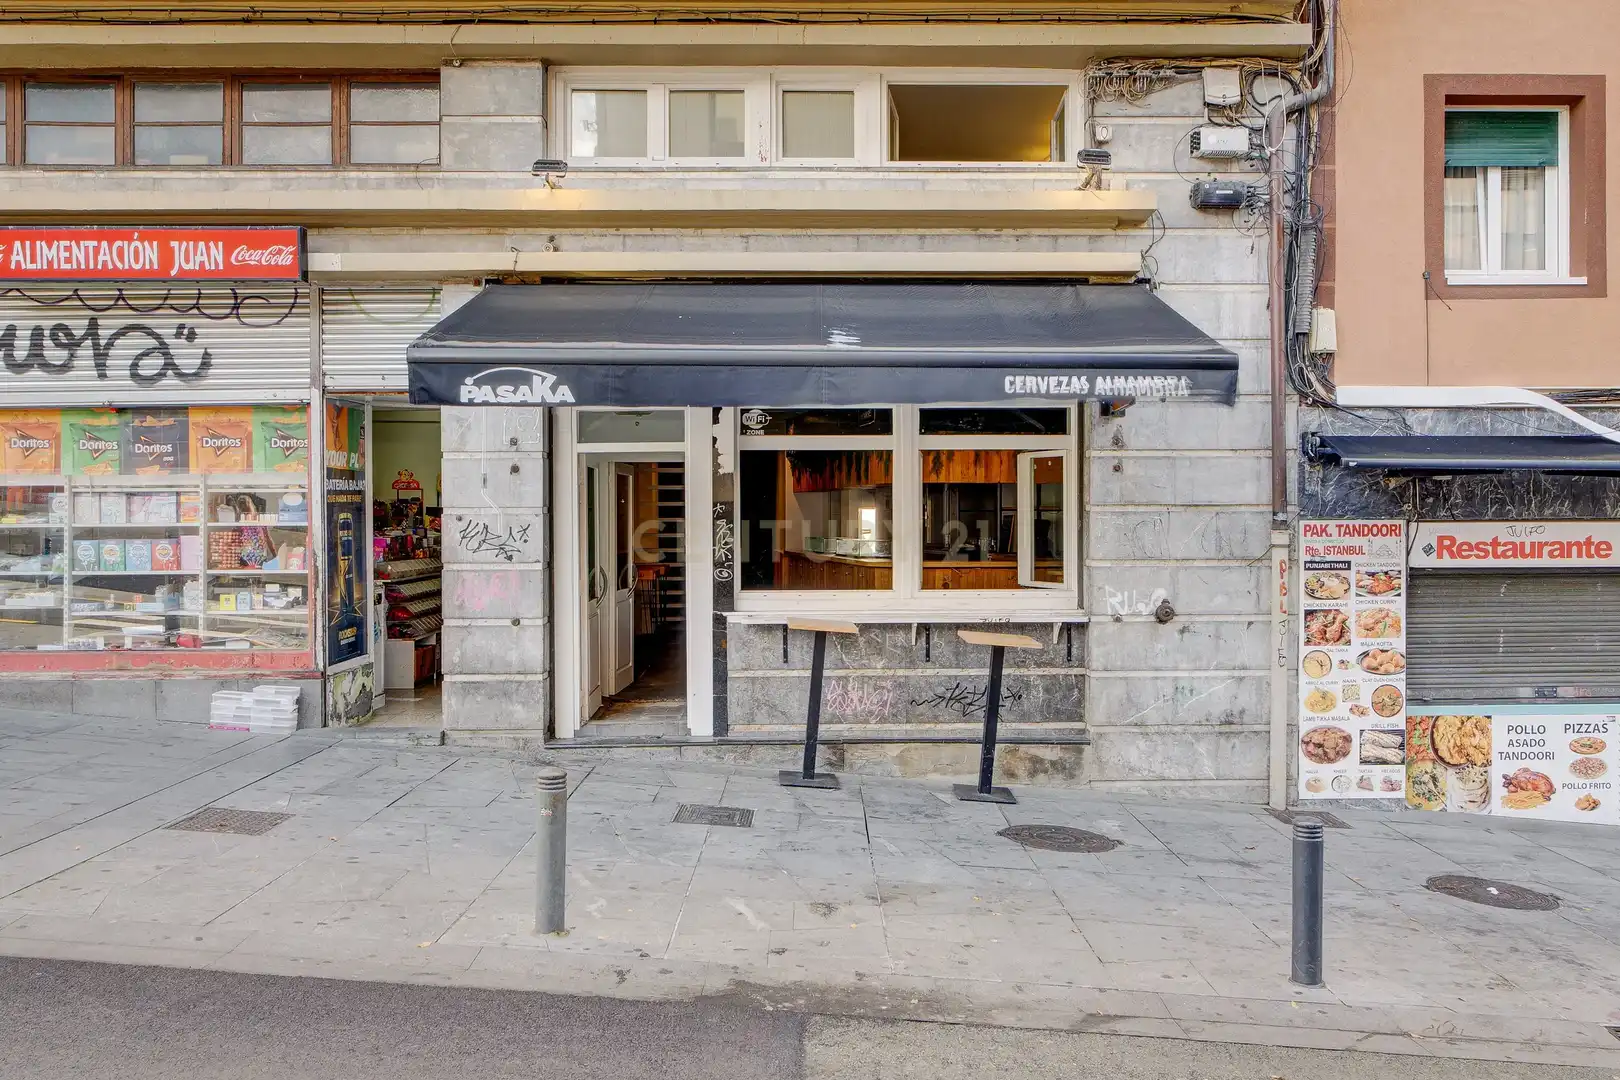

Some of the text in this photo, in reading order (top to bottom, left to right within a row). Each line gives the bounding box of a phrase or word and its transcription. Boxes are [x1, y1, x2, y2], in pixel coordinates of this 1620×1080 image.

[10, 232, 158, 270] ALIMENTACIÓN
[170, 240, 223, 276] JUAN
[231, 245, 297, 265] Coca-Cola
[460, 367, 576, 403] PASAKA
[1004, 375, 1193, 397] CERVEZAS ALHAMBRA
[11, 438, 51, 449] Doritos
[79, 440, 119, 450] Doritos
[135, 443, 173, 453] Doritos
[202, 437, 241, 448] Doritos
[1303, 524, 1402, 538] PAK. TANDOORI
[1305, 545, 1366, 556] Rte. ISTANBUL
[1436, 535, 1613, 560] Restaurante
[1507, 724, 1546, 735] POLLO
[1564, 723, 1609, 734] PIZZAS
[1507, 738, 1546, 748] ASADO
[1498, 751, 1555, 761] TANDOORI
[1562, 782, 1612, 790] POLLO FRITO
